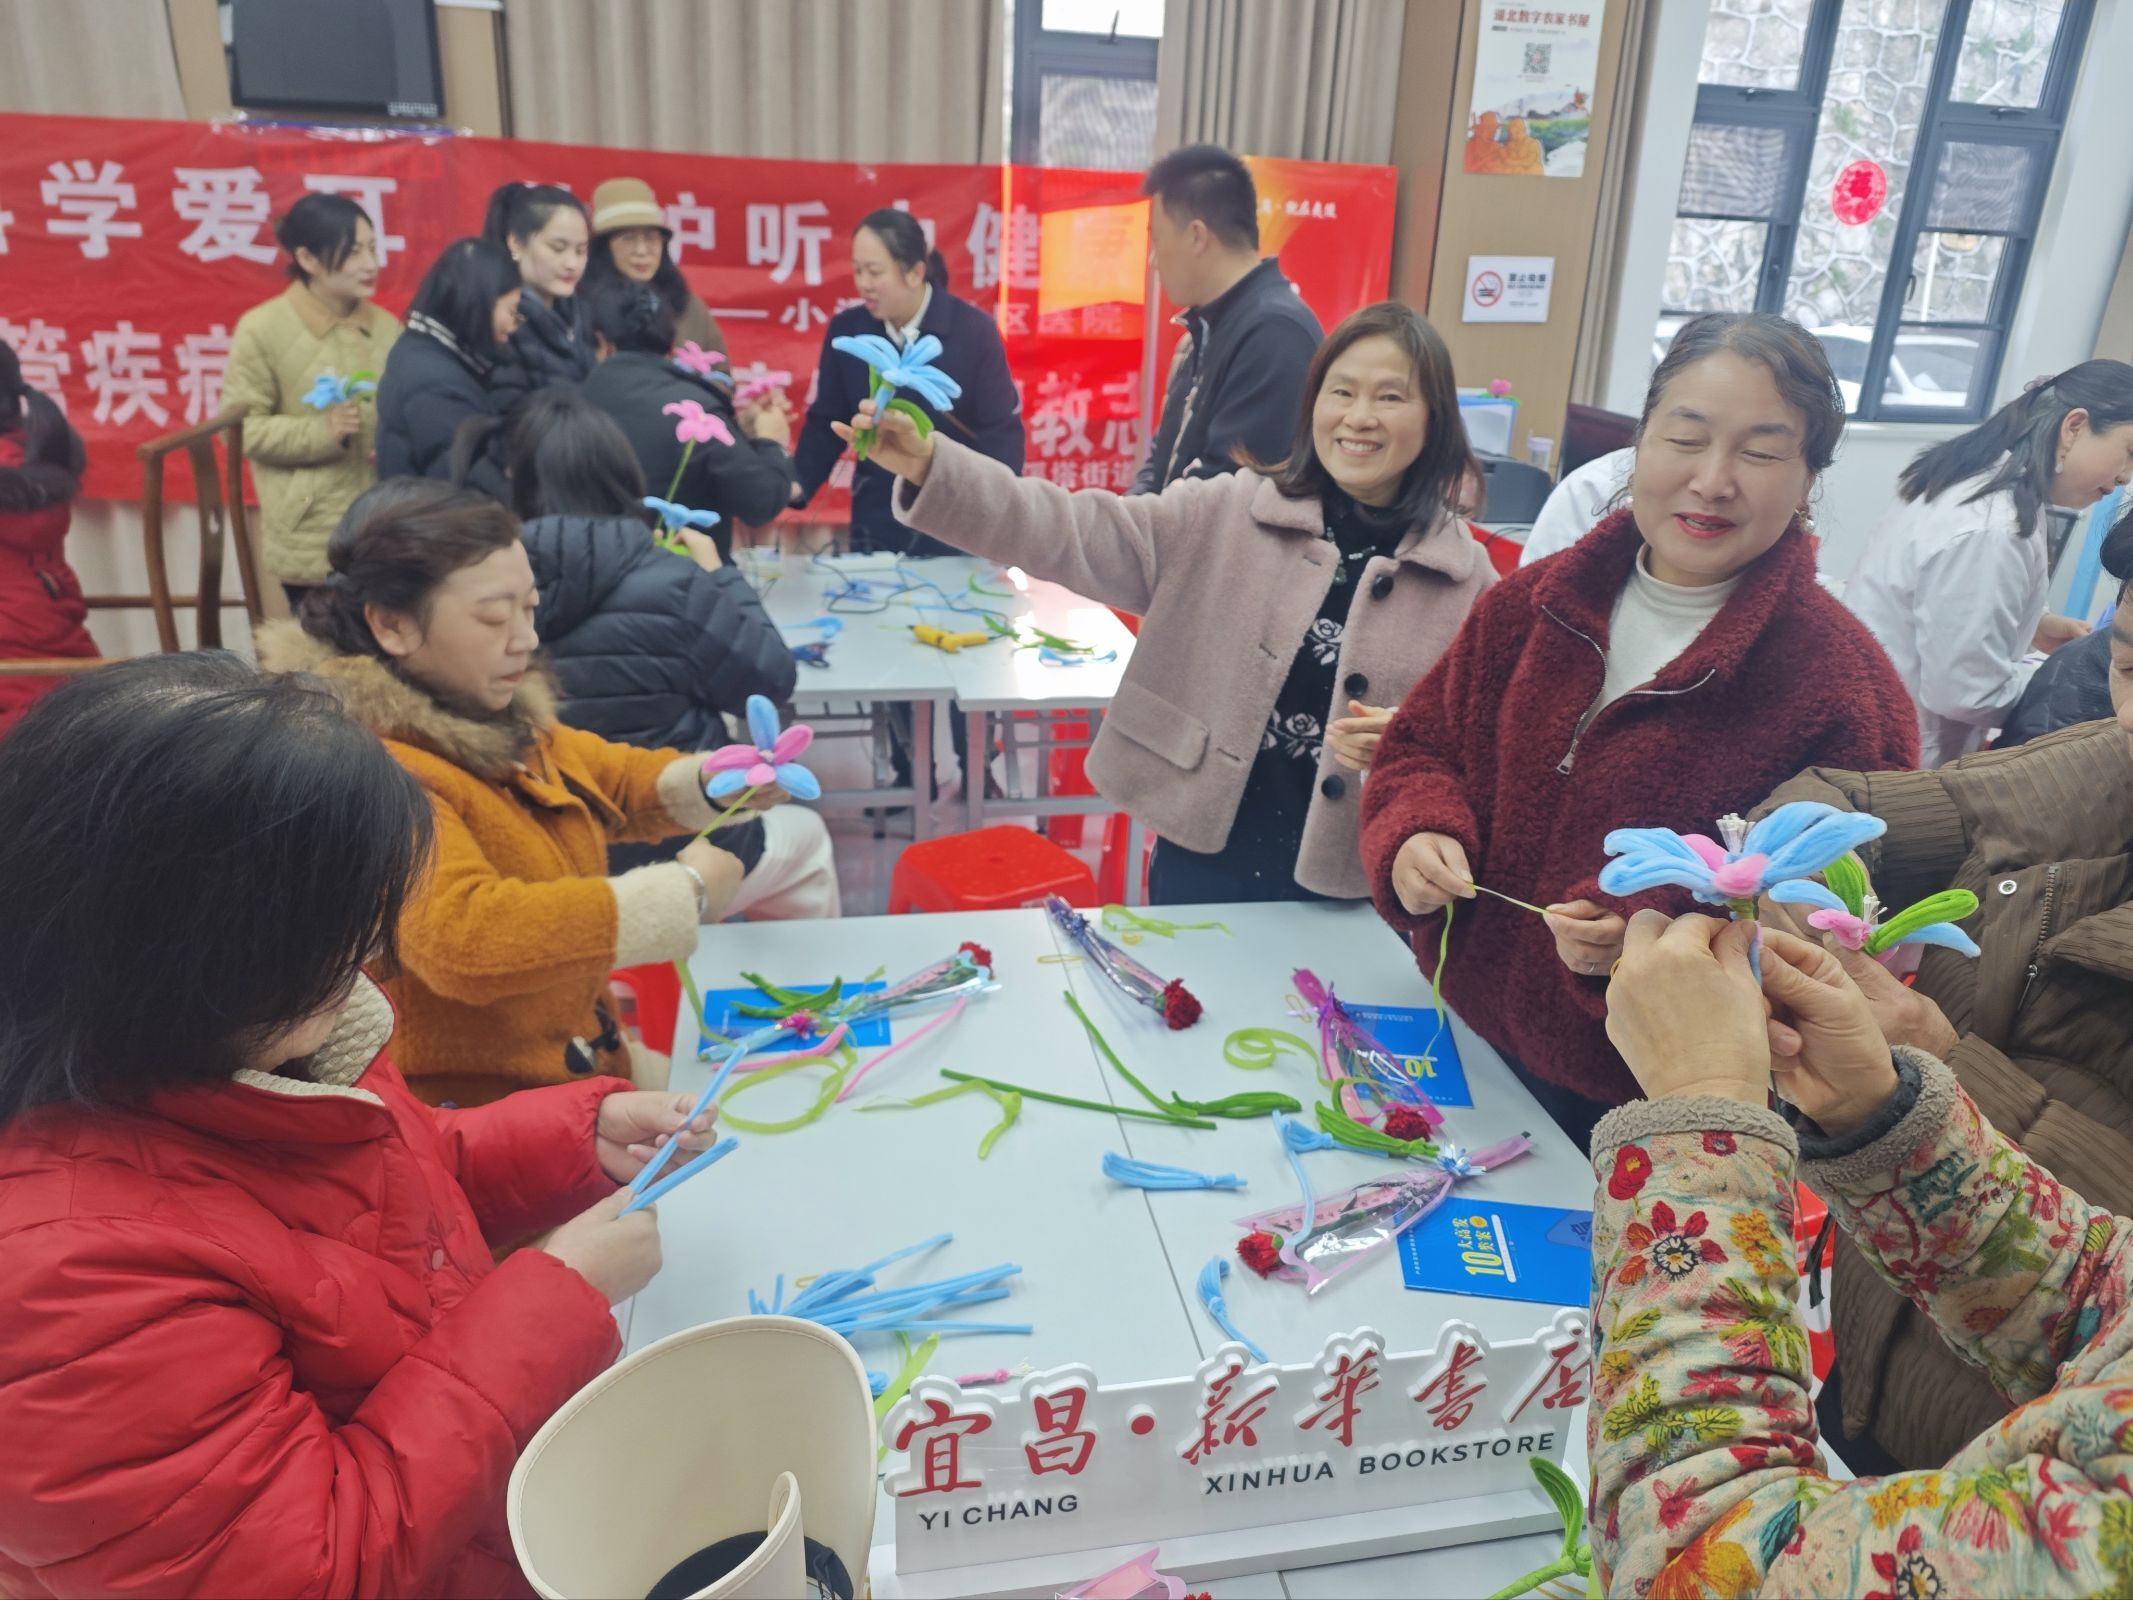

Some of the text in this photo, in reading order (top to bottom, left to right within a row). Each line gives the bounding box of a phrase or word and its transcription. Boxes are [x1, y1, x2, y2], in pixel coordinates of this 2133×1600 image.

[1461, 1251, 1505, 1276] 10
[1206, 1432, 1554, 1495] XINHUA BOOKSTORE
[919, 1494, 1078, 1531] YI CHANG
